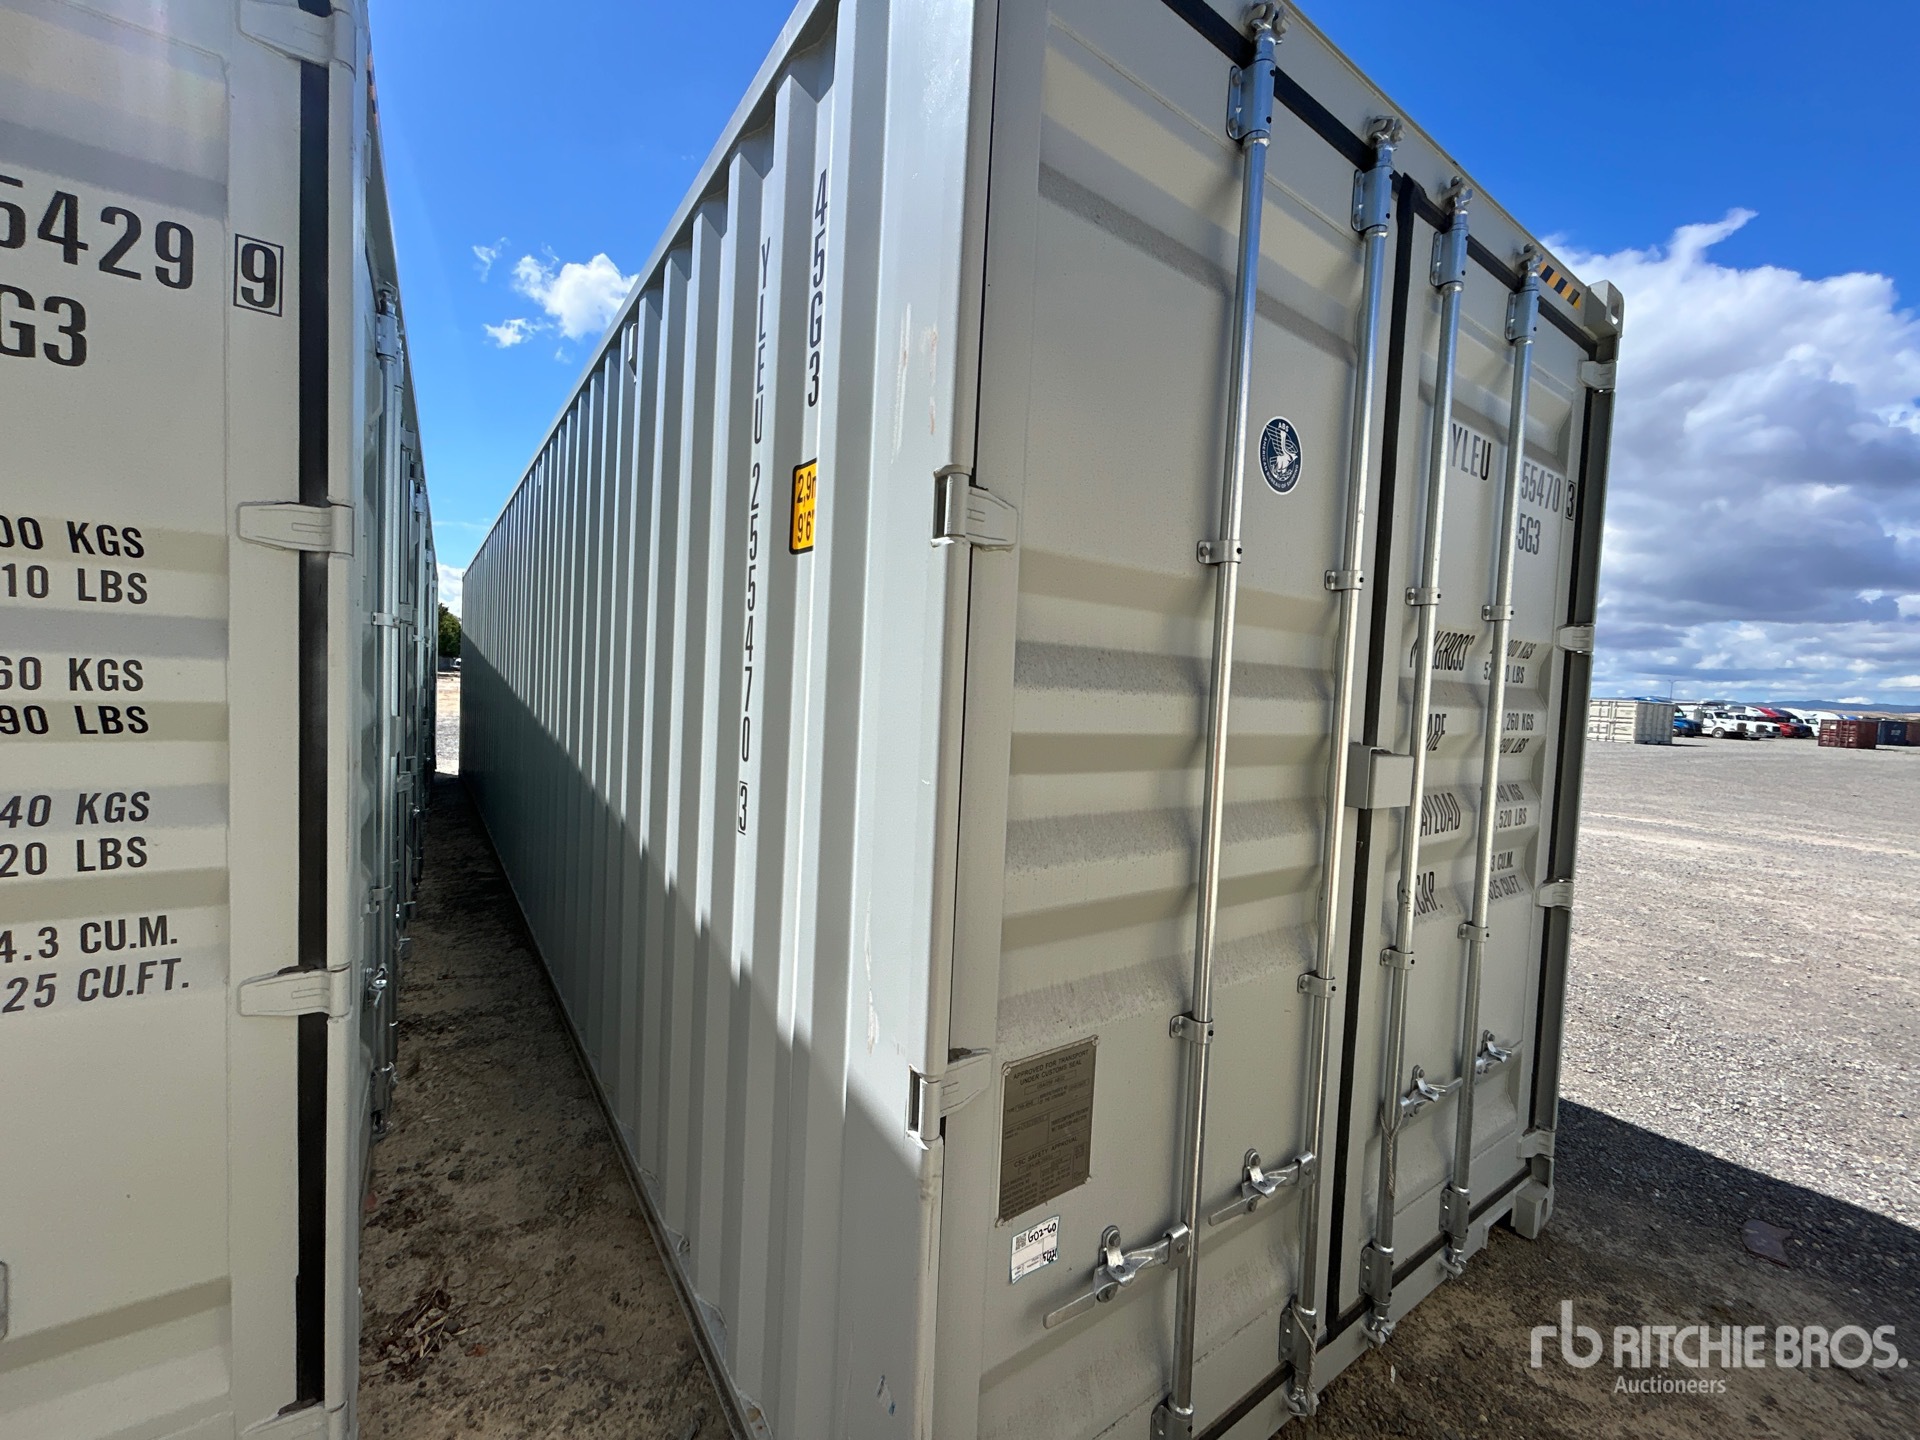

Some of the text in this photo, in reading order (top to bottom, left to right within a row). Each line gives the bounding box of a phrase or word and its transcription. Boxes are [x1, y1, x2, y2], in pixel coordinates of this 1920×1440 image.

[240, 243, 277, 309] 9
[808, 169, 828, 408] 45G3
[0, 284, 87, 367] G3
[1452, 423, 1575, 518] YLEU 55470 3
[67, 521, 145, 559] KGS
[739, 237, 770, 832] YLEU 255470 3
[1516, 513, 1541, 555] 5G3
[2, 563, 148, 605] 10 LBS
[69, 657, 144, 692] KGS
[1512, 665, 1525, 683] LBS
[0, 705, 149, 735] 90 LBS
[1427, 713, 1447, 751] ARE
[1521, 712, 1534, 731] KGS
[1510, 738, 1530, 753] LBS
[0, 791, 150, 829] 40 KGS
[1420, 792, 1461, 836] AYLOAD
[1514, 807, 1527, 826] LBS
[0, 836, 148, 878] 20 LBS
[0, 915, 178, 963] 4.3 CU.M.
[2, 958, 190, 1013] 25 CU.FT.
